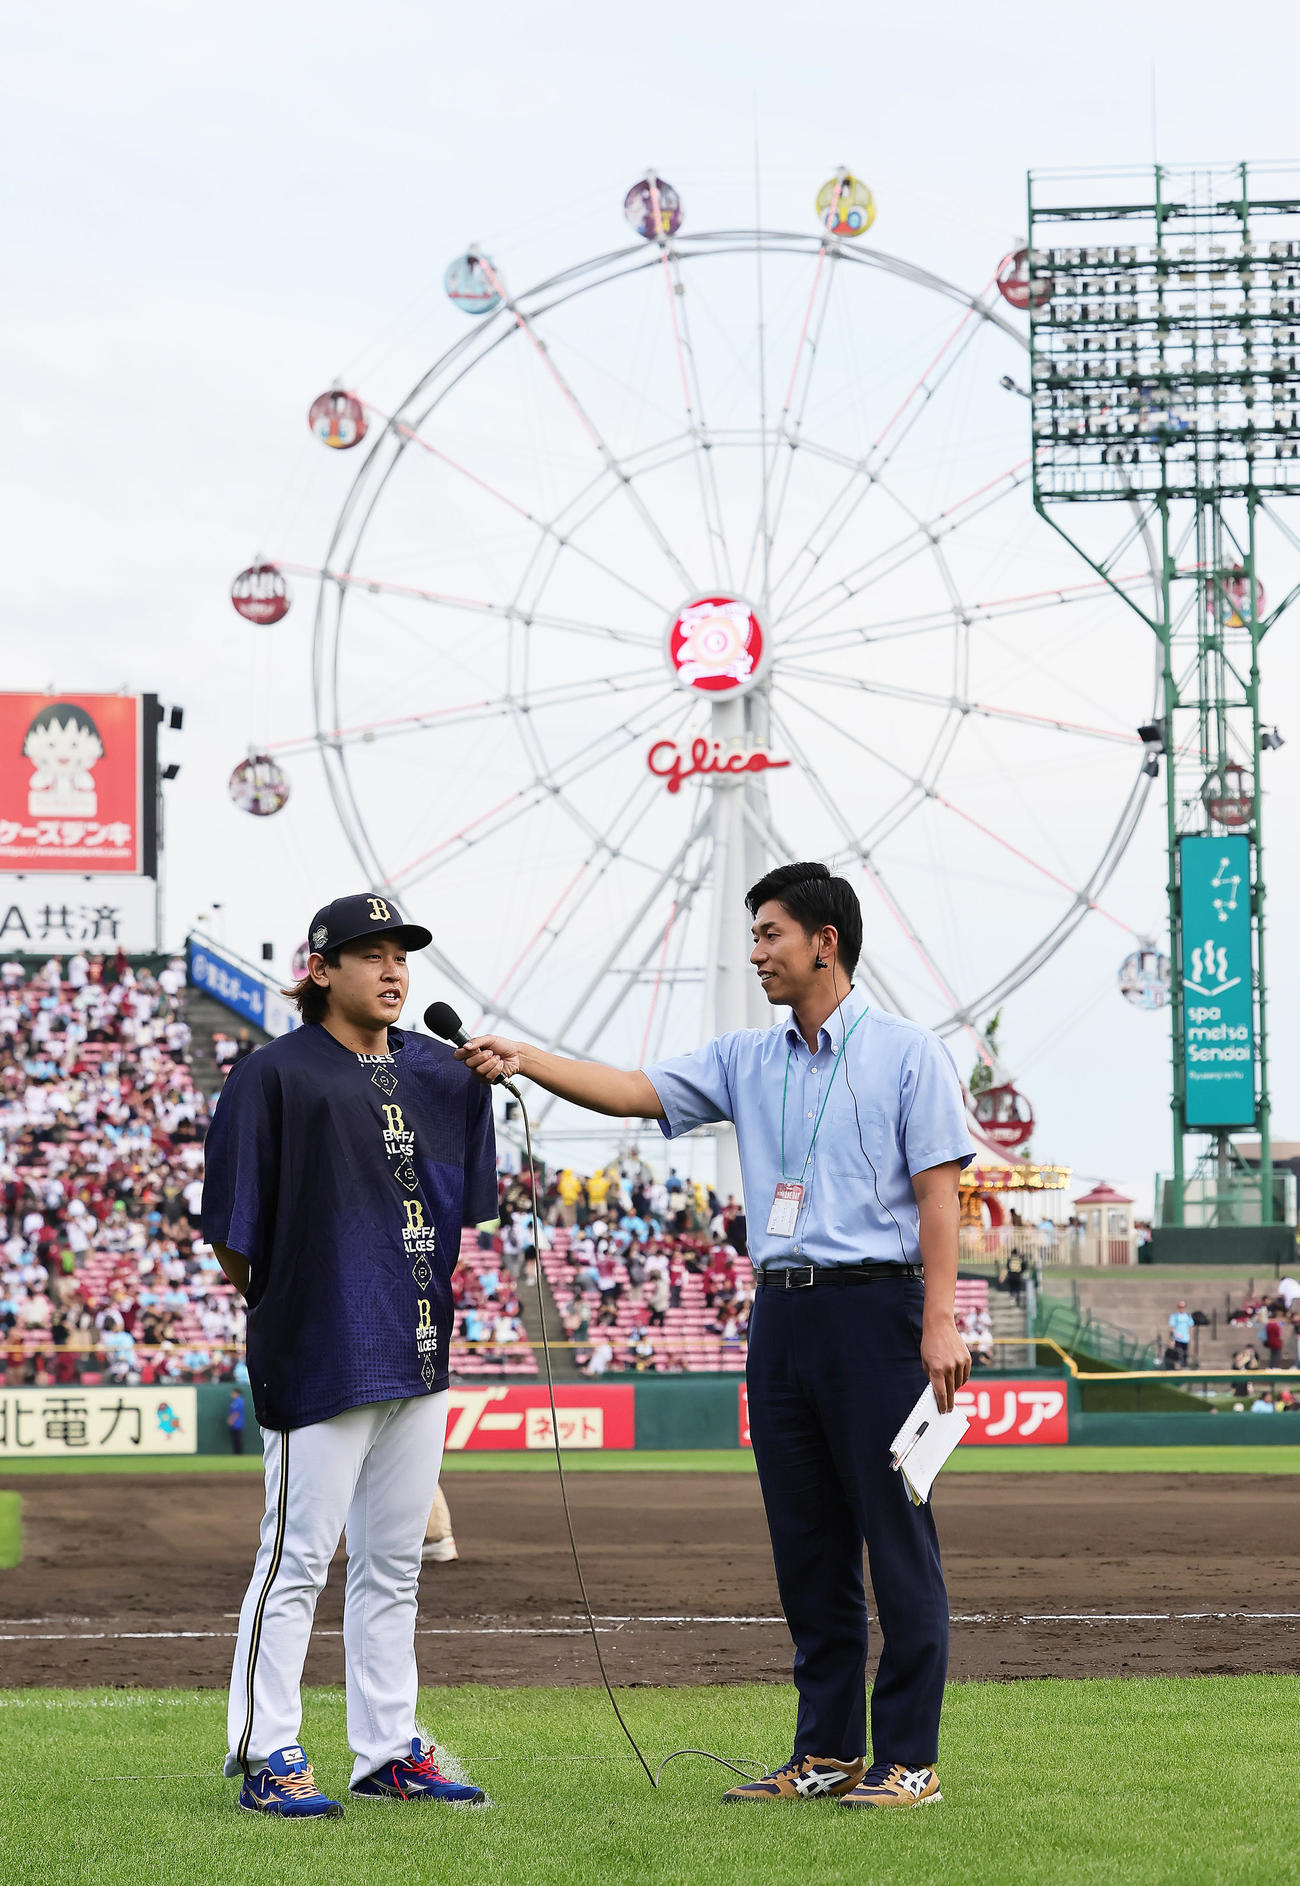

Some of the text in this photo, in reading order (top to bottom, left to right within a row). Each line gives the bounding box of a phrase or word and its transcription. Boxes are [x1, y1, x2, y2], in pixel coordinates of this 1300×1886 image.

[367, 898, 391, 922] B
[1188, 1007, 1221, 1025] spa
[1188, 1044, 1250, 1062] Sendai
[382, 1104, 404, 1138] B
[403, 1200, 424, 1232] B
[417, 1299, 431, 1332] B
[0, 1398, 142, 1447] 北電力
[534, 1415, 597, 1441] ネット
